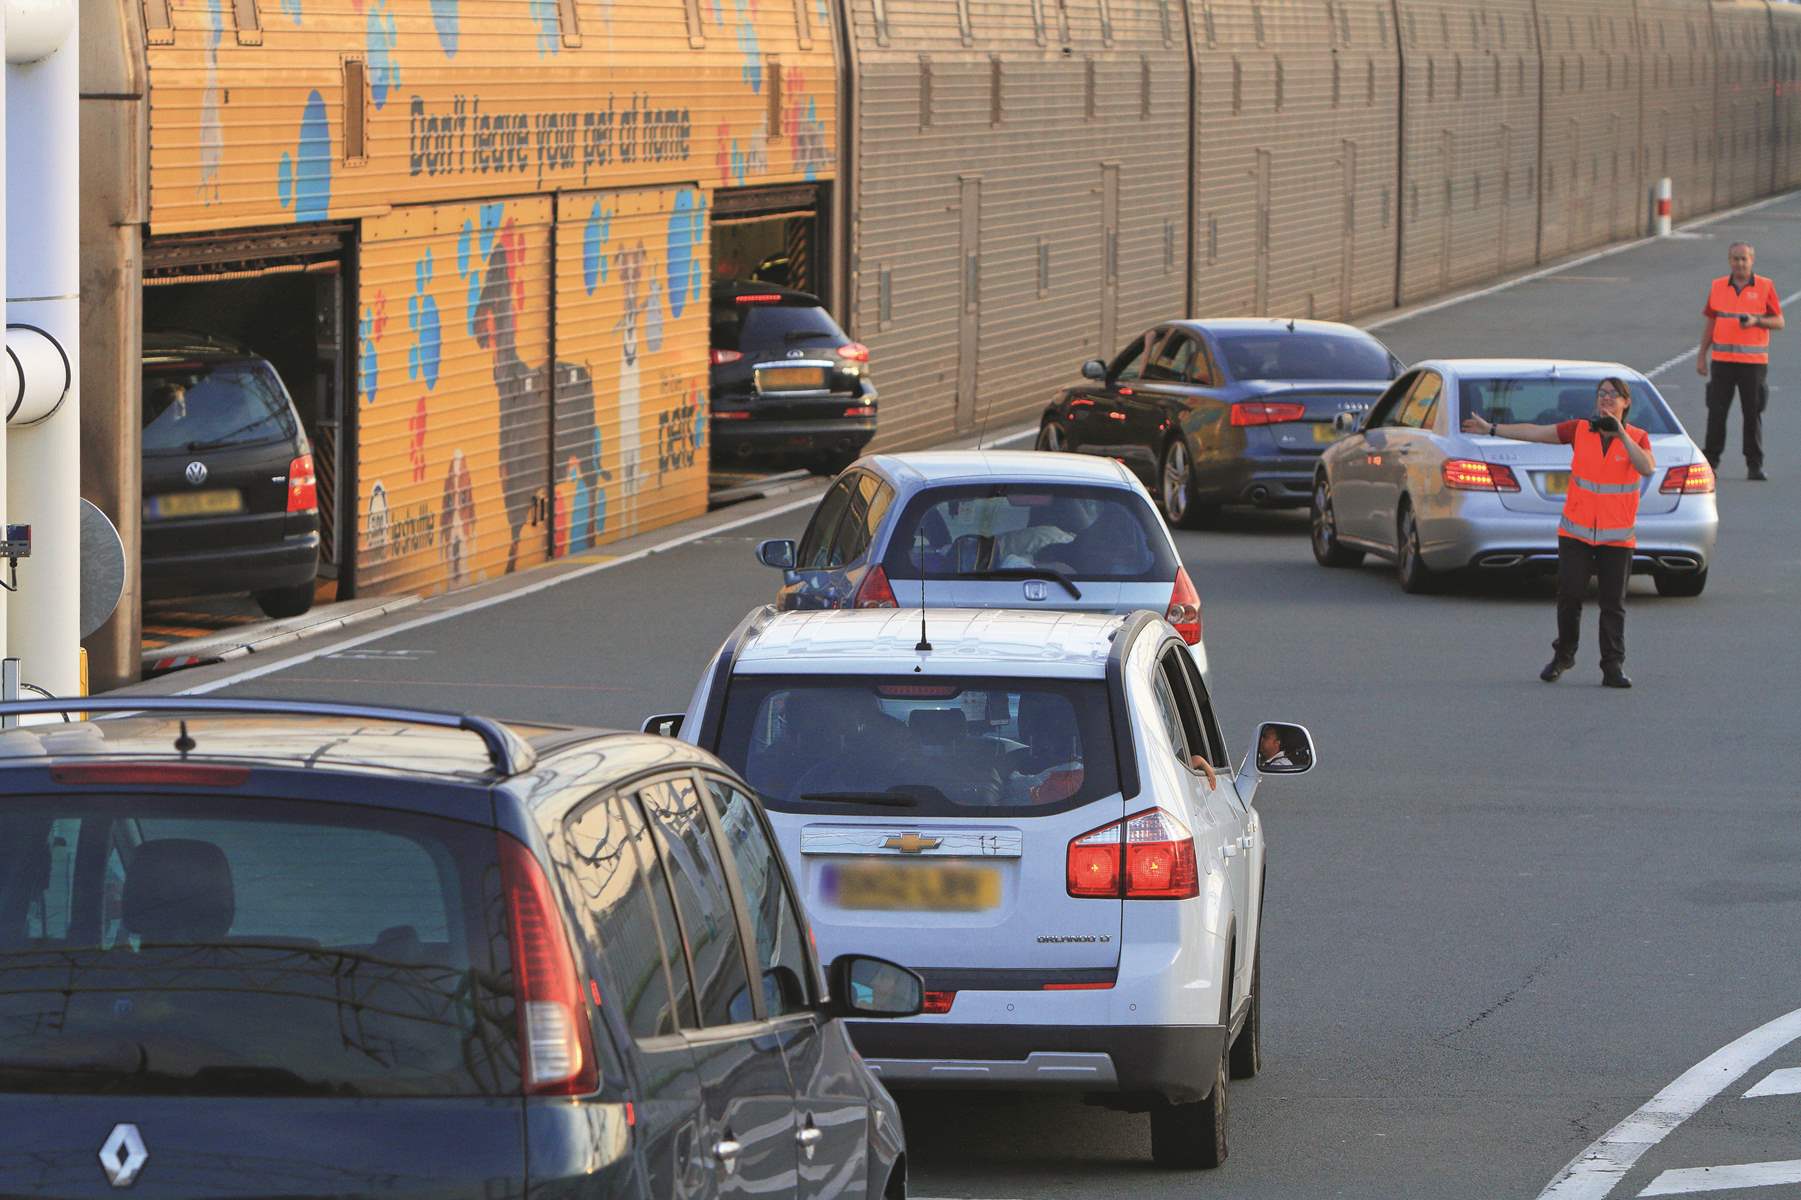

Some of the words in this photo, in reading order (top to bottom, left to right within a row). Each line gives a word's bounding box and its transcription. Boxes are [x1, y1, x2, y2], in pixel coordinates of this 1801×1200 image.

[410, 94, 466, 176] Don't
[472, 93, 529, 174] leave
[535, 112, 577, 190] your
[583, 91, 615, 186] pet
[619, 91, 638, 163] at
[642, 91, 691, 163] home
[1036, 935, 1097, 944] ORLANDO
[1099, 934, 1113, 943] LT
